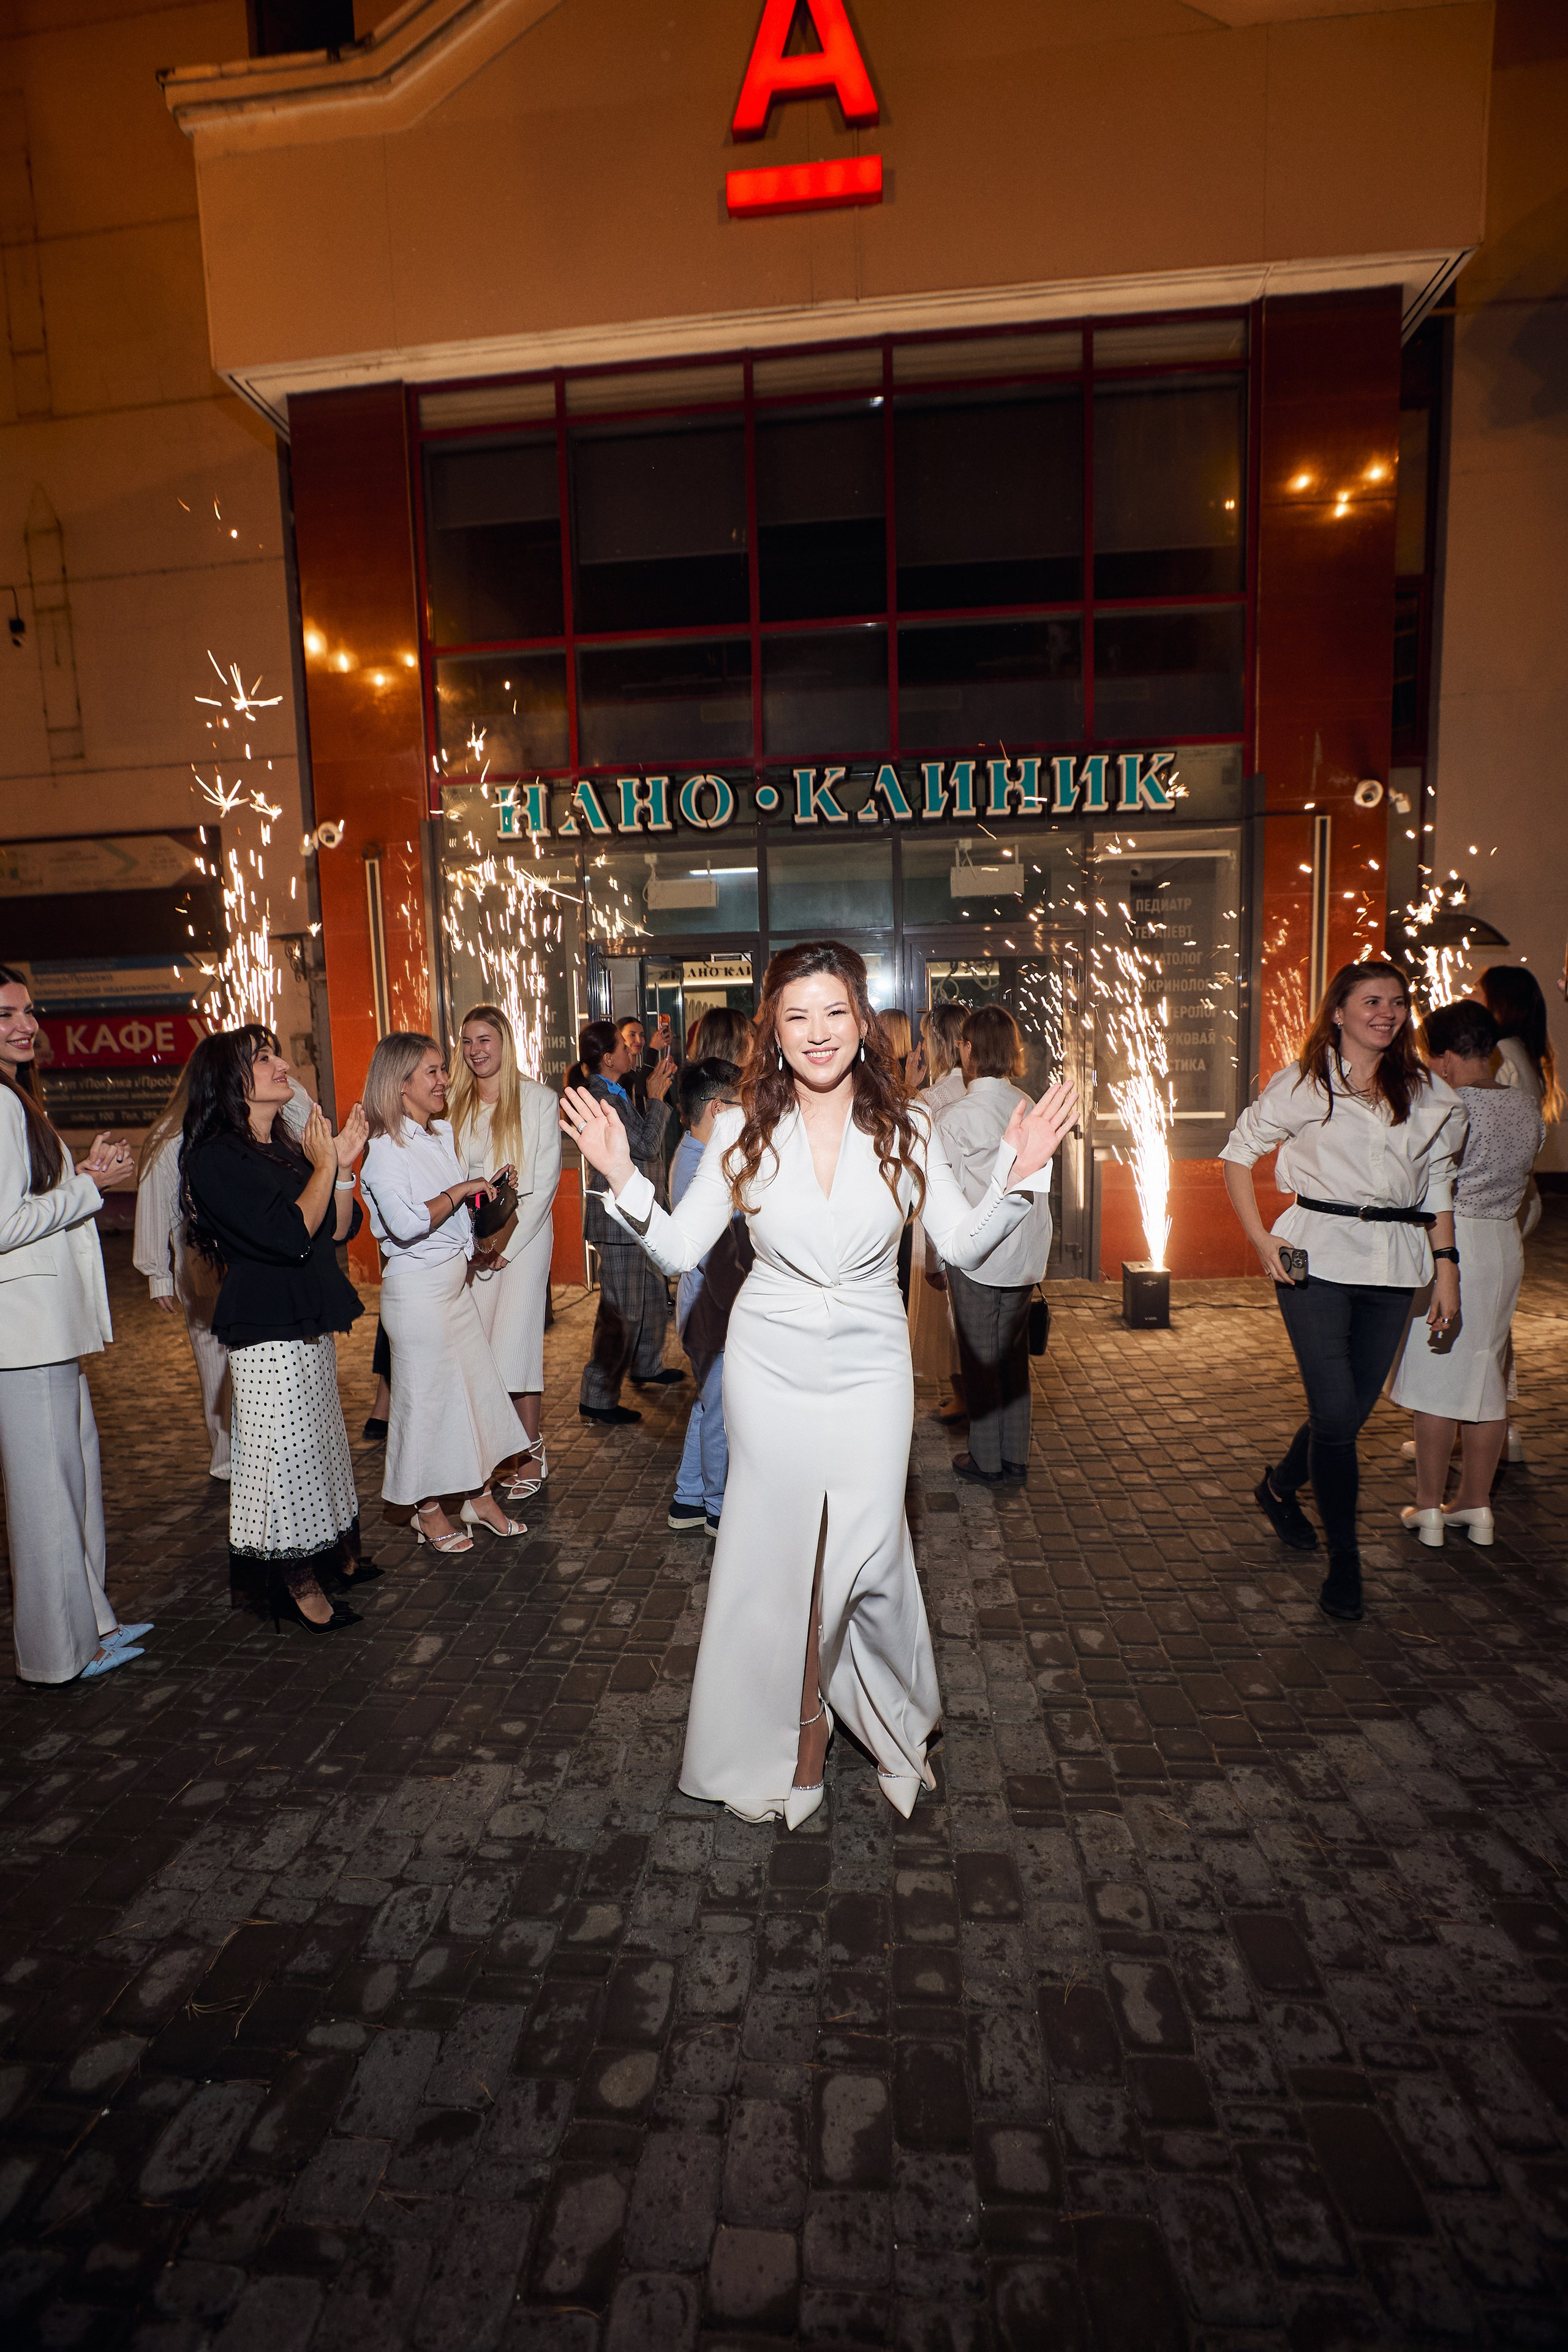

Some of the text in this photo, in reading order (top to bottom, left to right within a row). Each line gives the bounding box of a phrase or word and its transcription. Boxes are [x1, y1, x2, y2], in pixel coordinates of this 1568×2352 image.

[494, 752, 1176, 839] НАНО КЛИНИК
[1136, 897, 1191, 913] ПЕДИАТР
[65, 1020, 175, 1055] КАФЕ
